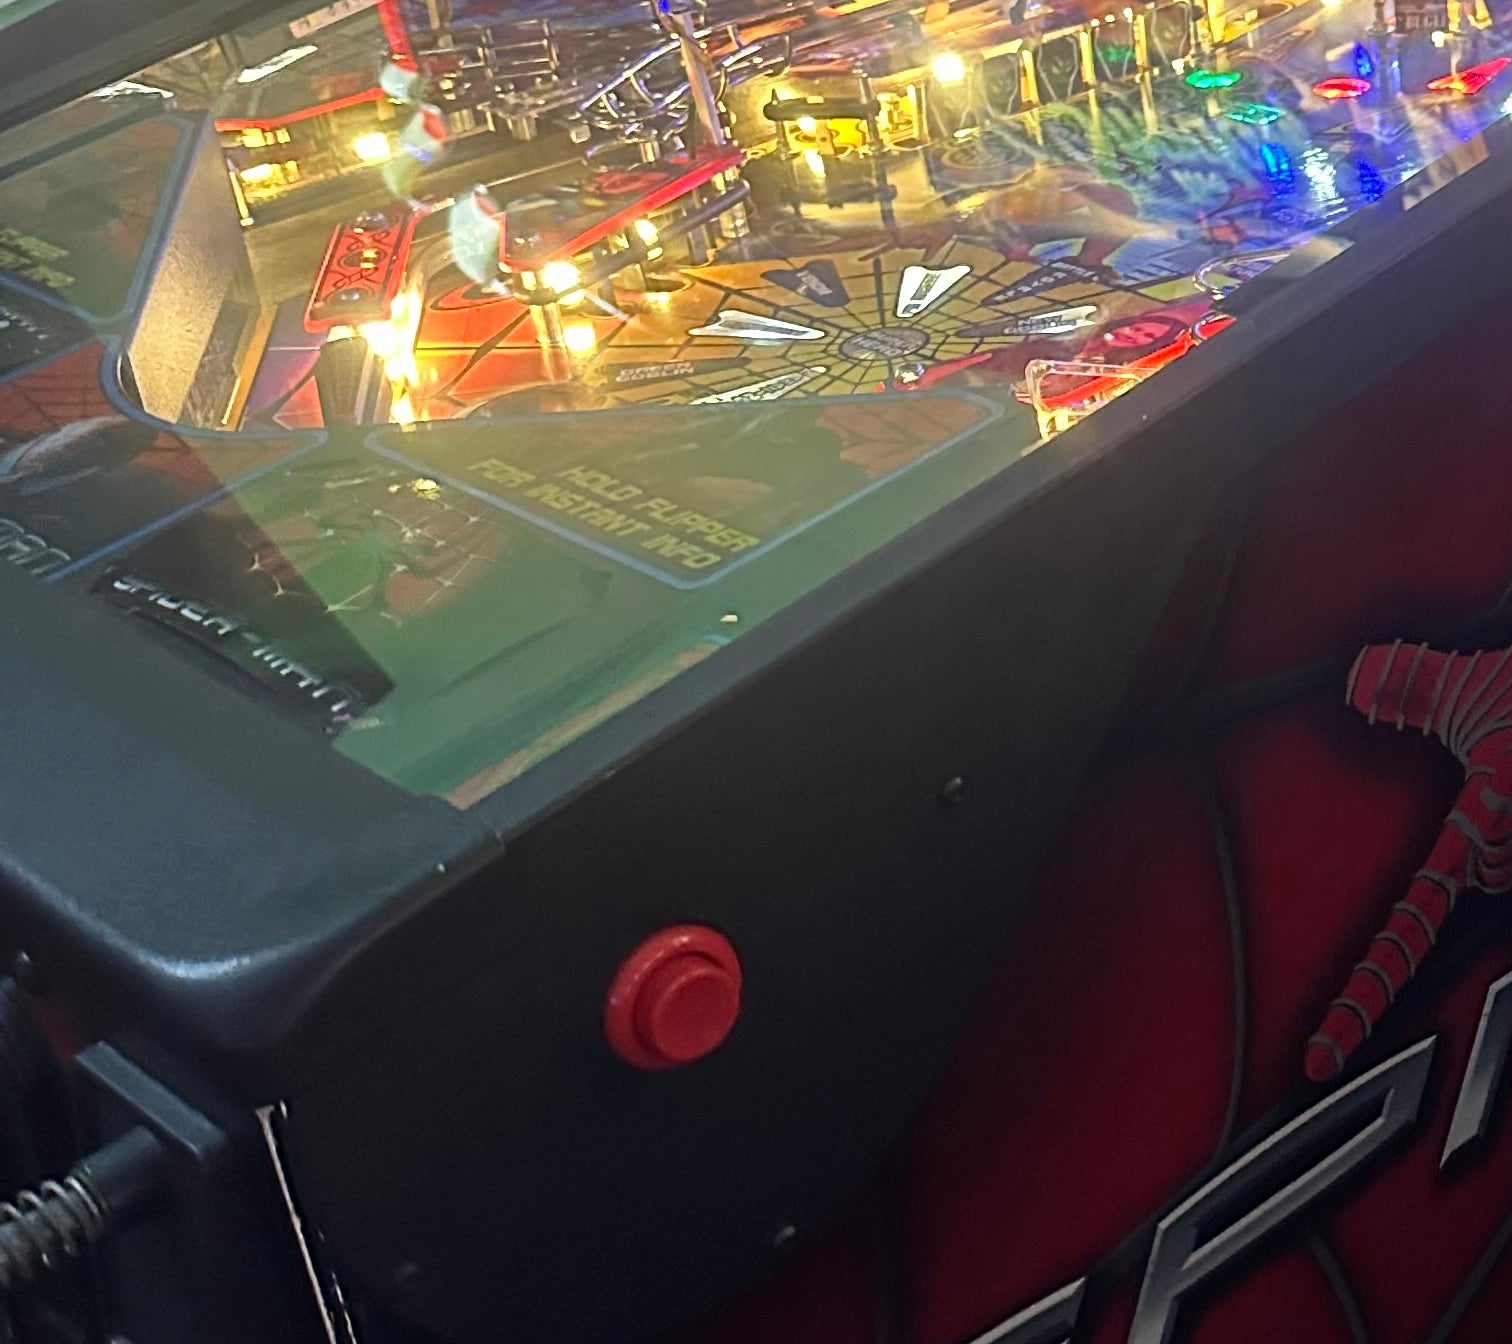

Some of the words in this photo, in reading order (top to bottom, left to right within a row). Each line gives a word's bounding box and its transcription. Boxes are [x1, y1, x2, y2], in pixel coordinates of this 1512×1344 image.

[466, 457, 537, 489] FOR
[523, 482, 651, 537] INSTANT
[641, 533, 722, 570] INFO
[556, 465, 643, 502] HOLD
[634, 497, 762, 553] FLIPPER
